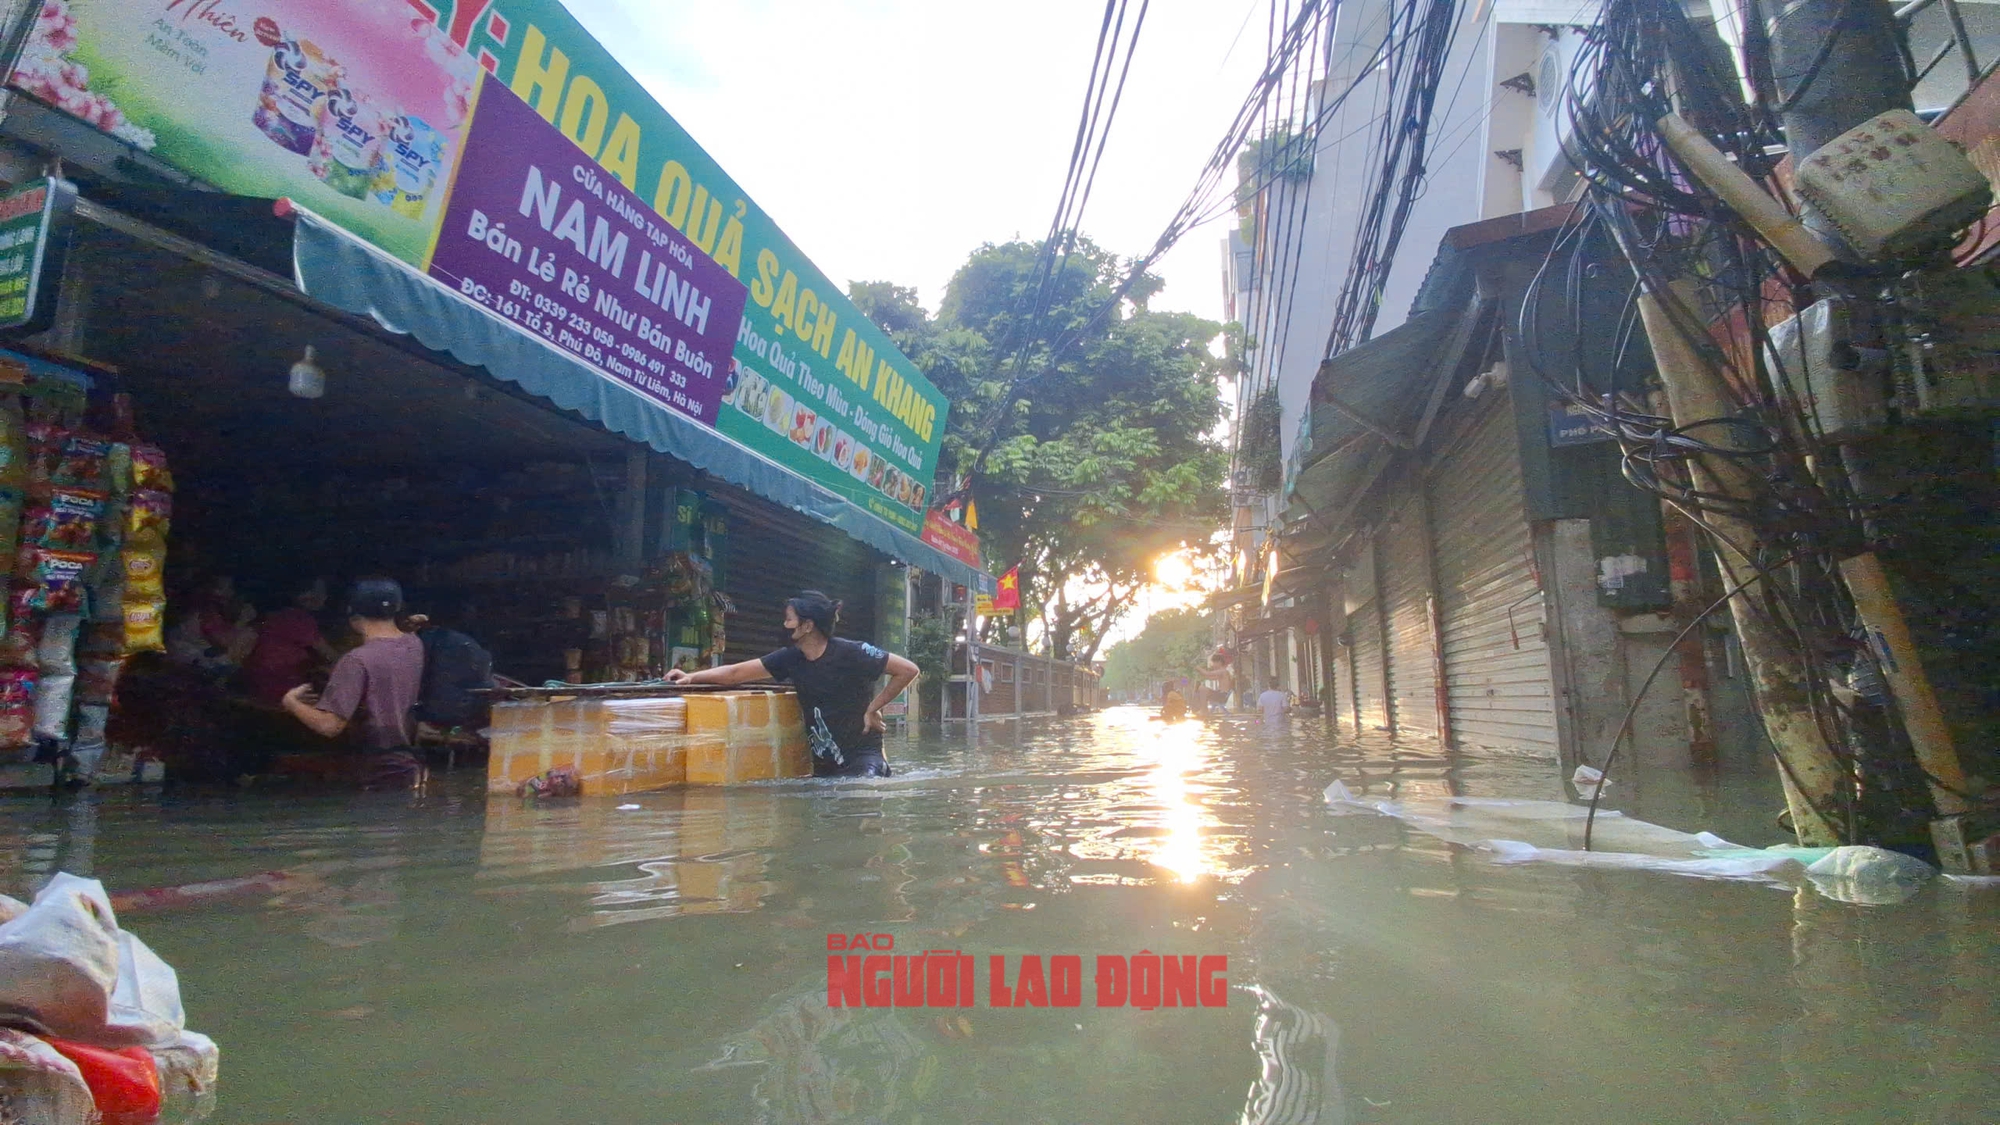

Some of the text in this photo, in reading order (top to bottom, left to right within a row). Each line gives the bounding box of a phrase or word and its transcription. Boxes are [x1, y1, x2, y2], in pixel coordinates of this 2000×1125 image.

[283, 71, 326, 100] SPY
[336, 116, 376, 145] SPY
[395, 143, 431, 168] SPY
[509, 23, 641, 194] HOA
[654, 160, 747, 280] QUẢ
[751, 248, 838, 359] SẠCH
[835, 328, 875, 391] AN
[872, 359, 936, 443] KHANG
[518, 164, 713, 335] NAM LINH
[572, 164, 694, 271] CỬA HÀNG TẠP HÓA
[460, 277, 493, 305] ĐC:
[495, 295, 522, 321] 161
[525, 311, 545, 331] Tổ
[543, 322, 556, 341] 3,
[558, 328, 583, 352] Phú
[606, 354, 633, 379] Nam
[633, 369, 648, 386] Từ
[646, 376, 672, 402] Liêm,
[672, 390, 687, 407] Hà
[687, 397, 704, 417] Nội
[466, 209, 714, 380] Bán Lẻ Rẻ Như Bán Buôn
[509, 278, 533, 303] ĐT:
[534, 293, 568, 321] 0339
[568, 312, 592, 335] 233
[592, 326, 615, 348] 058
[621, 343, 648, 366] 0986
[647, 359, 667, 377] 491
[669, 370, 688, 389] 333
[737, 316, 768, 359] Hoa
[768, 341, 797, 380] Quả
[797, 361, 826, 400] Theo
[825, 383, 850, 418] Mùa
[892, 437, 908, 458] Hoa
[61, 493, 95, 507] POCA
[51, 558, 83, 570] POCA
